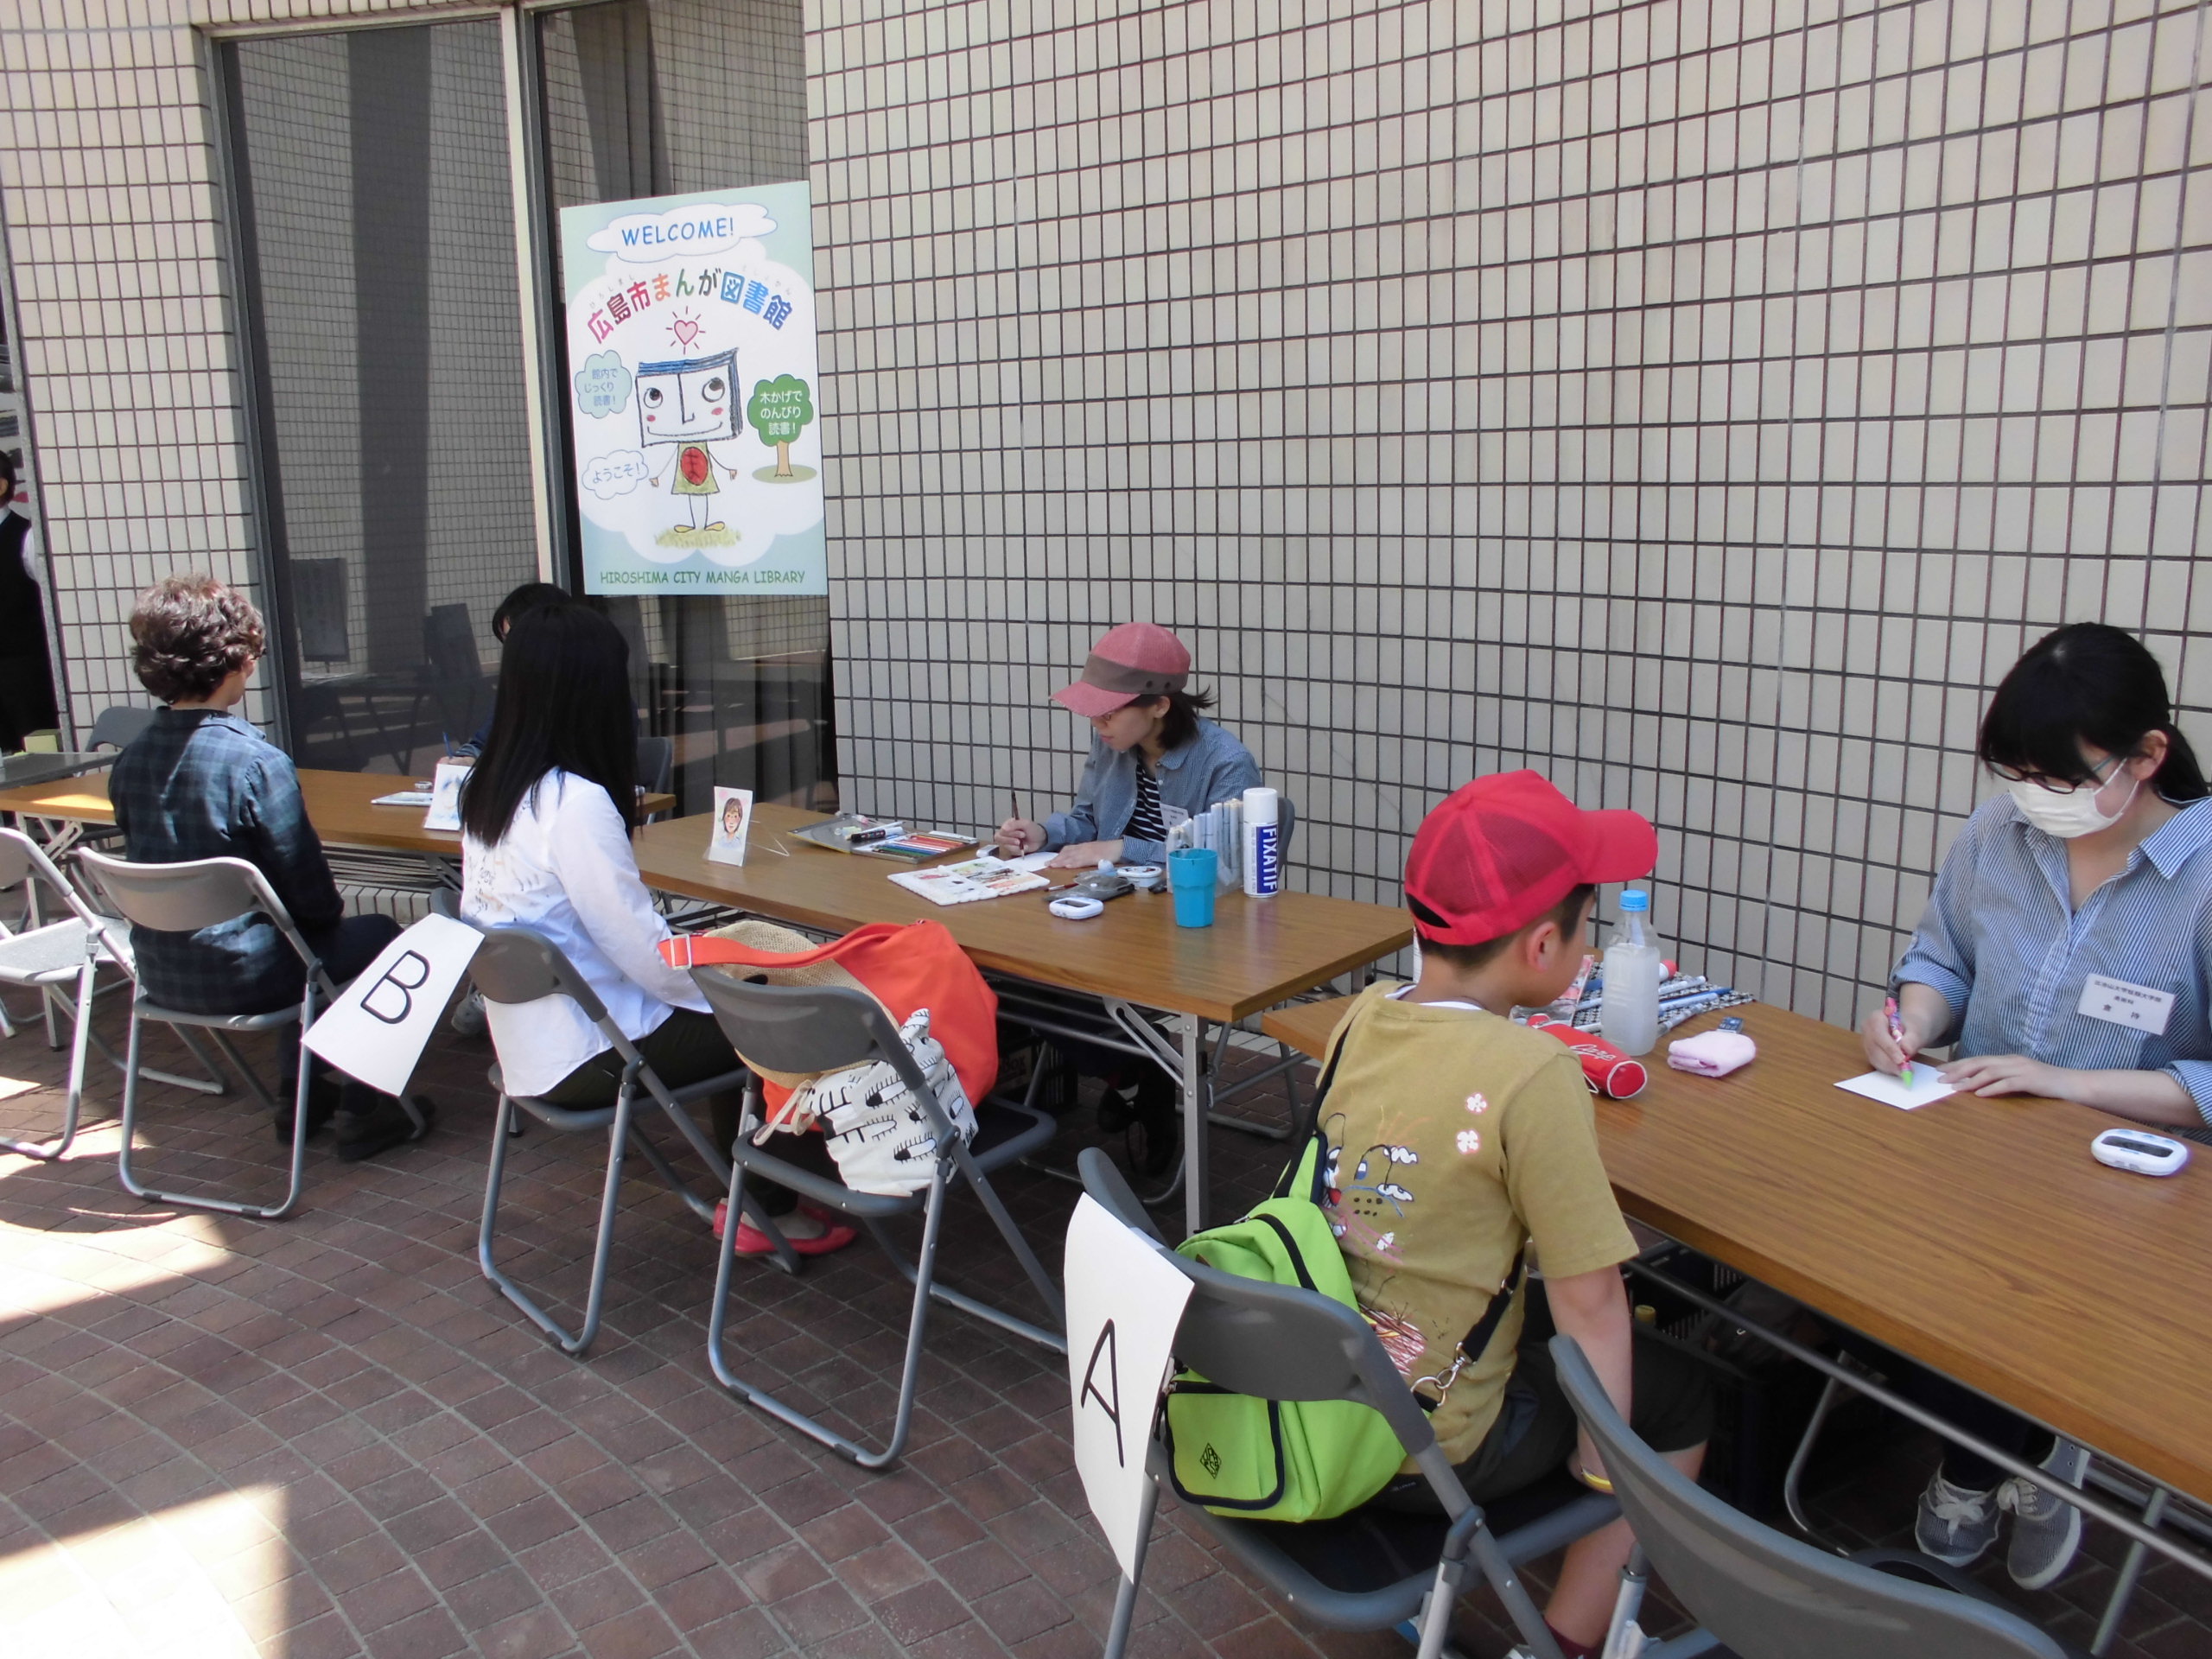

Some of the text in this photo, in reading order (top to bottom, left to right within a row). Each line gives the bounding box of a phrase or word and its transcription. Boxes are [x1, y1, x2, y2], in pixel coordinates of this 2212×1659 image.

[621, 217, 734, 247] WELCOME!
[587, 268, 792, 345] 広島市まんが図書館
[591, 368, 619, 380] 館内で
[583, 382, 614, 393] じっくり
[760, 390, 803, 404] 木かげで
[760, 406, 801, 420] のんびり
[600, 570, 806, 584] HIROSHIMA CITY MANGA LIBRARY
[1262, 827, 1277, 890] FIXATIF
[360, 950, 431, 1025] B
[1080, 1318, 1124, 1469] A
